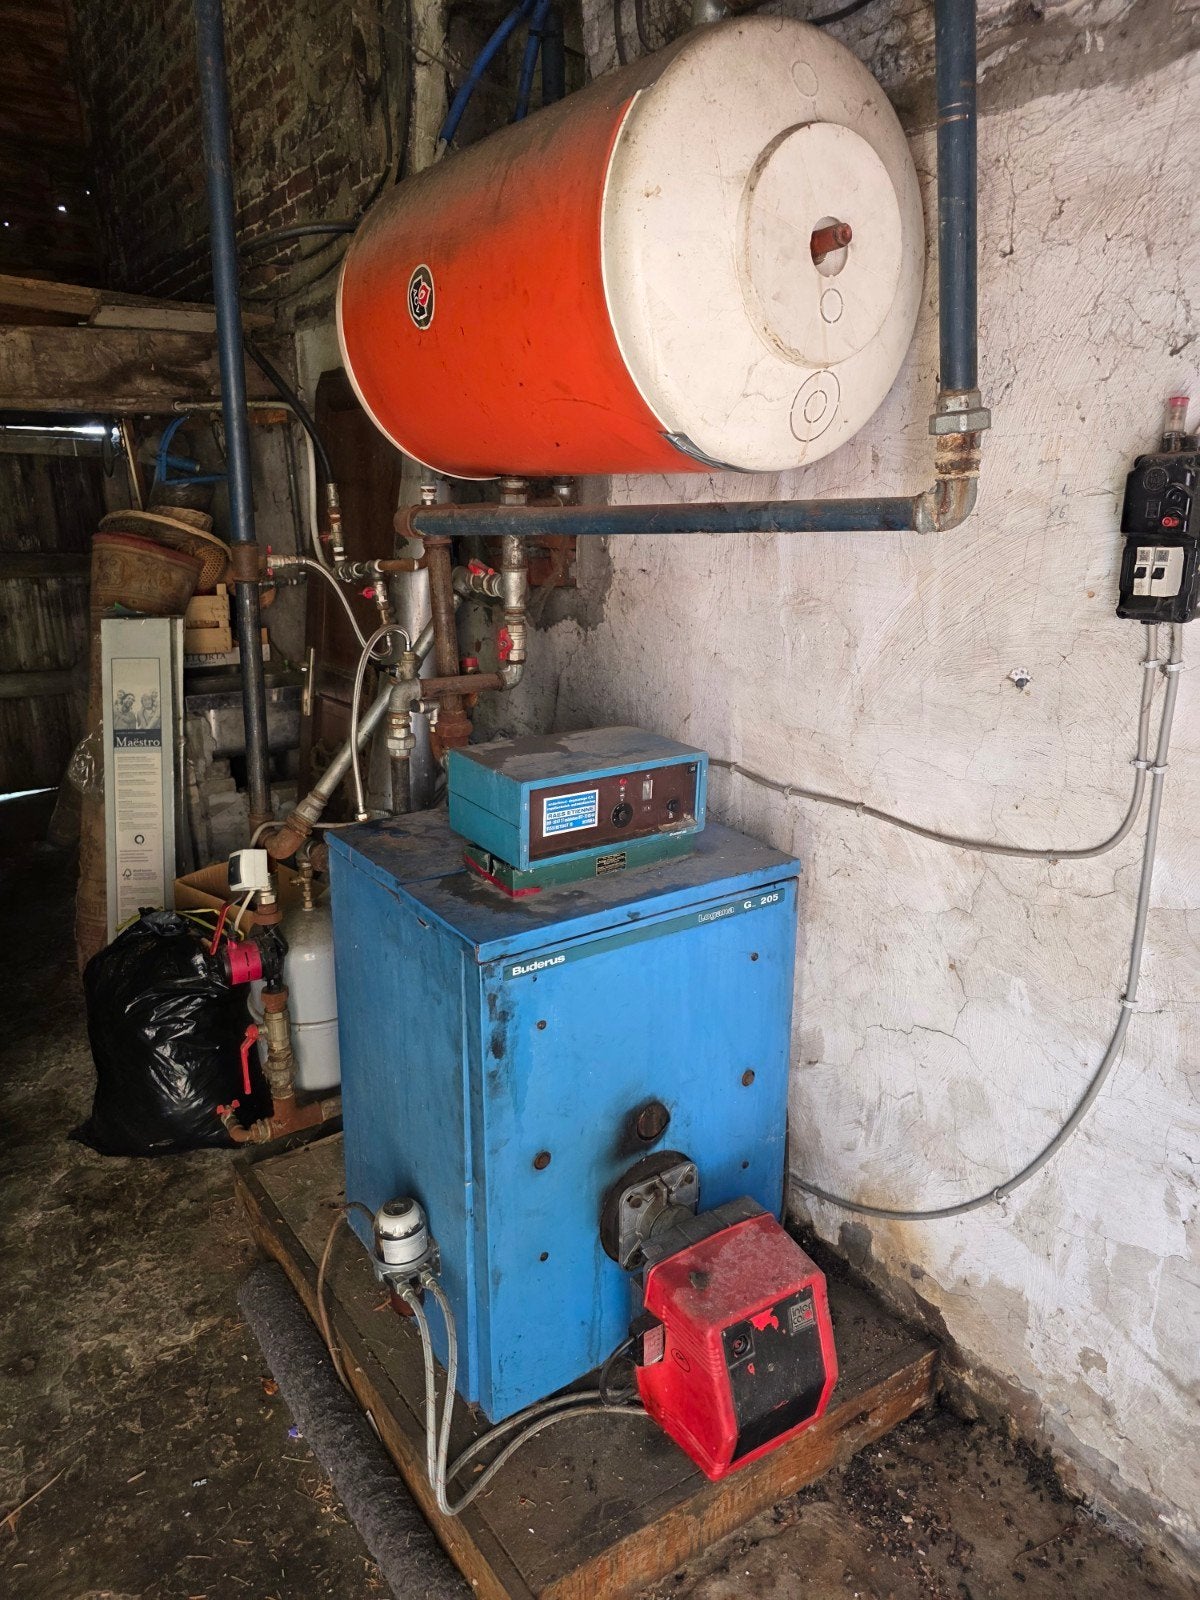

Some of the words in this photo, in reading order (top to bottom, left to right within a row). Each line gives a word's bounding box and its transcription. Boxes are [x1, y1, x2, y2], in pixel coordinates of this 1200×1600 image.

[184, 653, 226, 663] ELORTA
[116, 736, 160, 747] Maëstro
[760, 893, 779, 905] 205
[512, 955, 566, 976] Buderus
